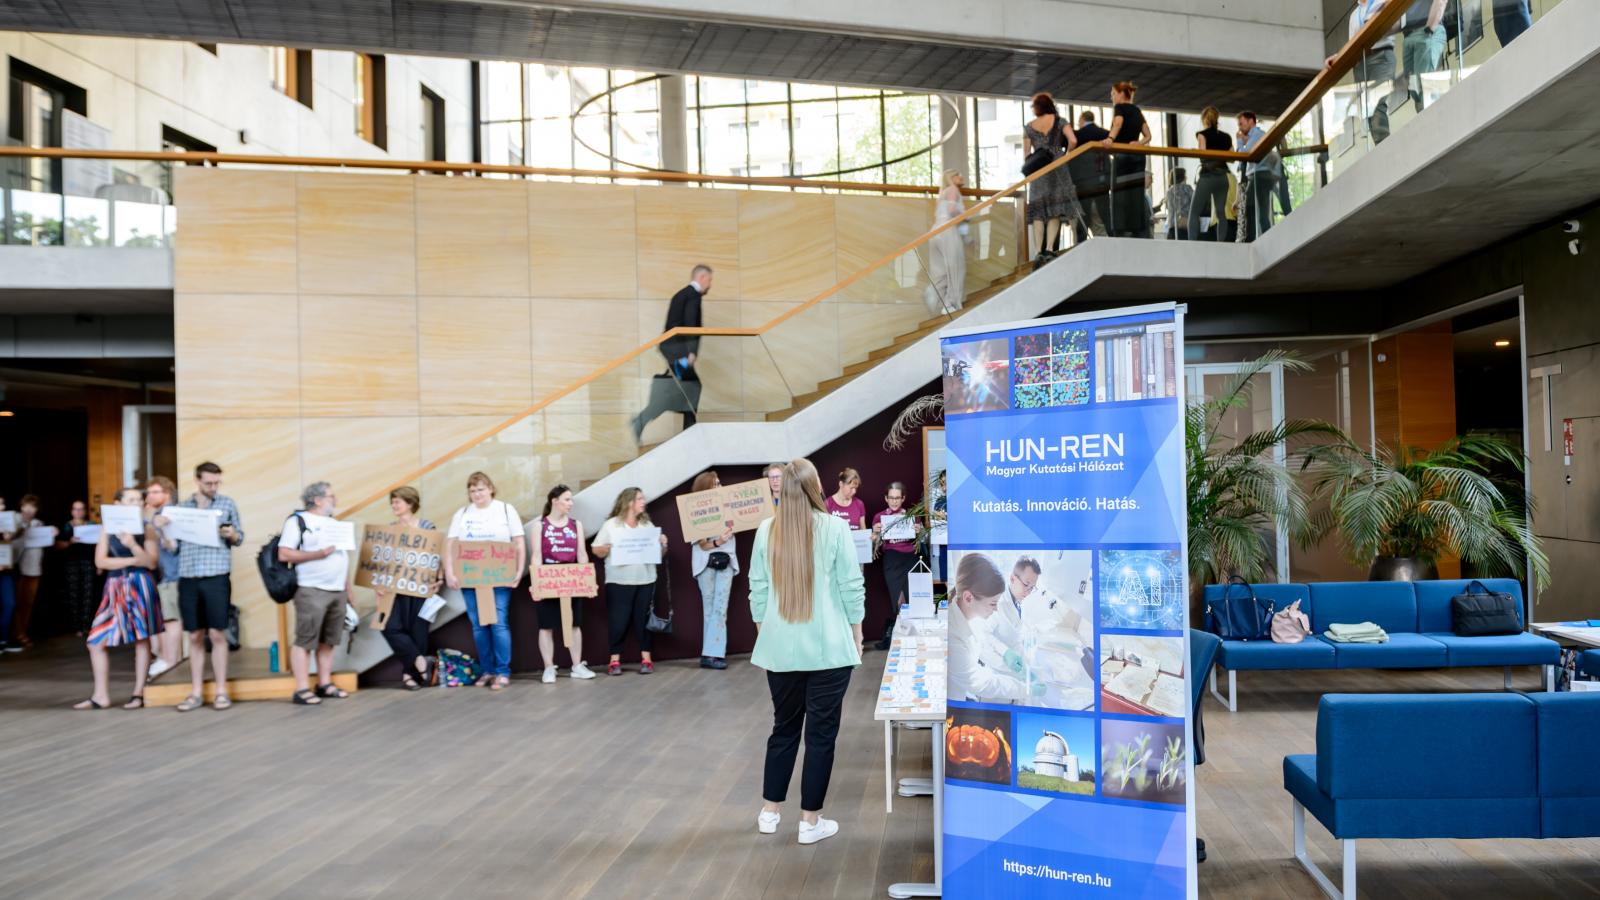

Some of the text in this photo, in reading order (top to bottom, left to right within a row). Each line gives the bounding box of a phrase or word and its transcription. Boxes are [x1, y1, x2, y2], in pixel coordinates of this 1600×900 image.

[985, 432, 1124, 463] HUN-REN
[986, 460, 1124, 478] Magyar Kutatási Hálózat
[973, 497, 1140, 513] Kutatás. Innováció. Hatás.
[364, 530, 396, 545] HAVI
[1118, 571, 1161, 606] AI
[1003, 859, 1111, 888] https://hun-ren.hu
